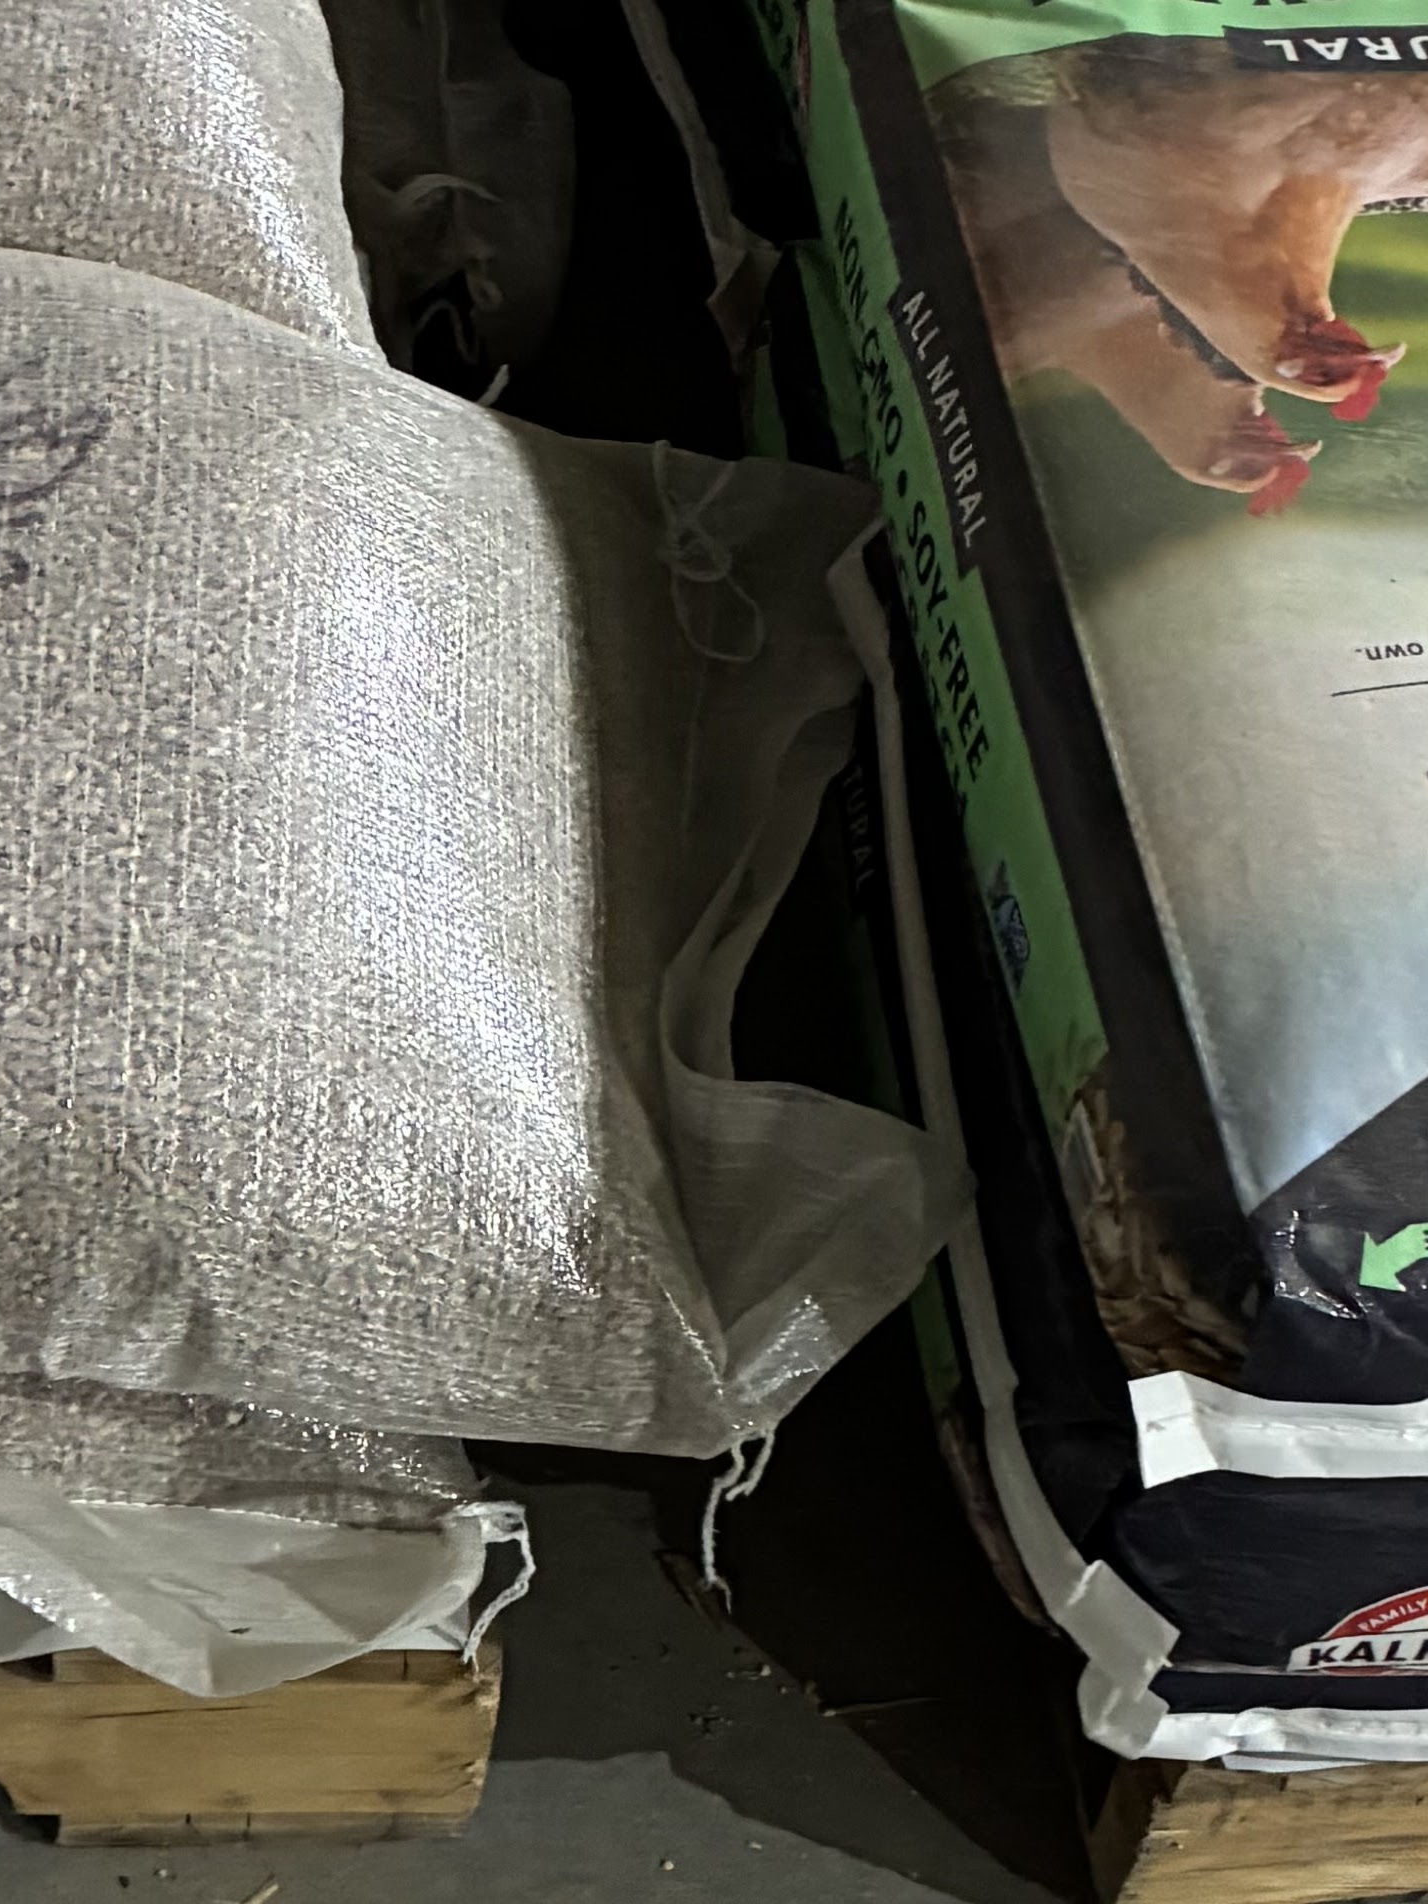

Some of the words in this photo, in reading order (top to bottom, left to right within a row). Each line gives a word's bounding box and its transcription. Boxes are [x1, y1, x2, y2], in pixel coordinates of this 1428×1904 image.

[902, 290, 941, 362] ALL
[926, 354, 987, 548] NATURAL
[834, 196, 903, 457] NON-GMO
[907, 499, 991, 783] SOY-FREE
[1355, 642, 1424, 663] own.
[844, 764, 876, 892] TURAL
[1358, 1598, 1428, 1633] FAMILY
